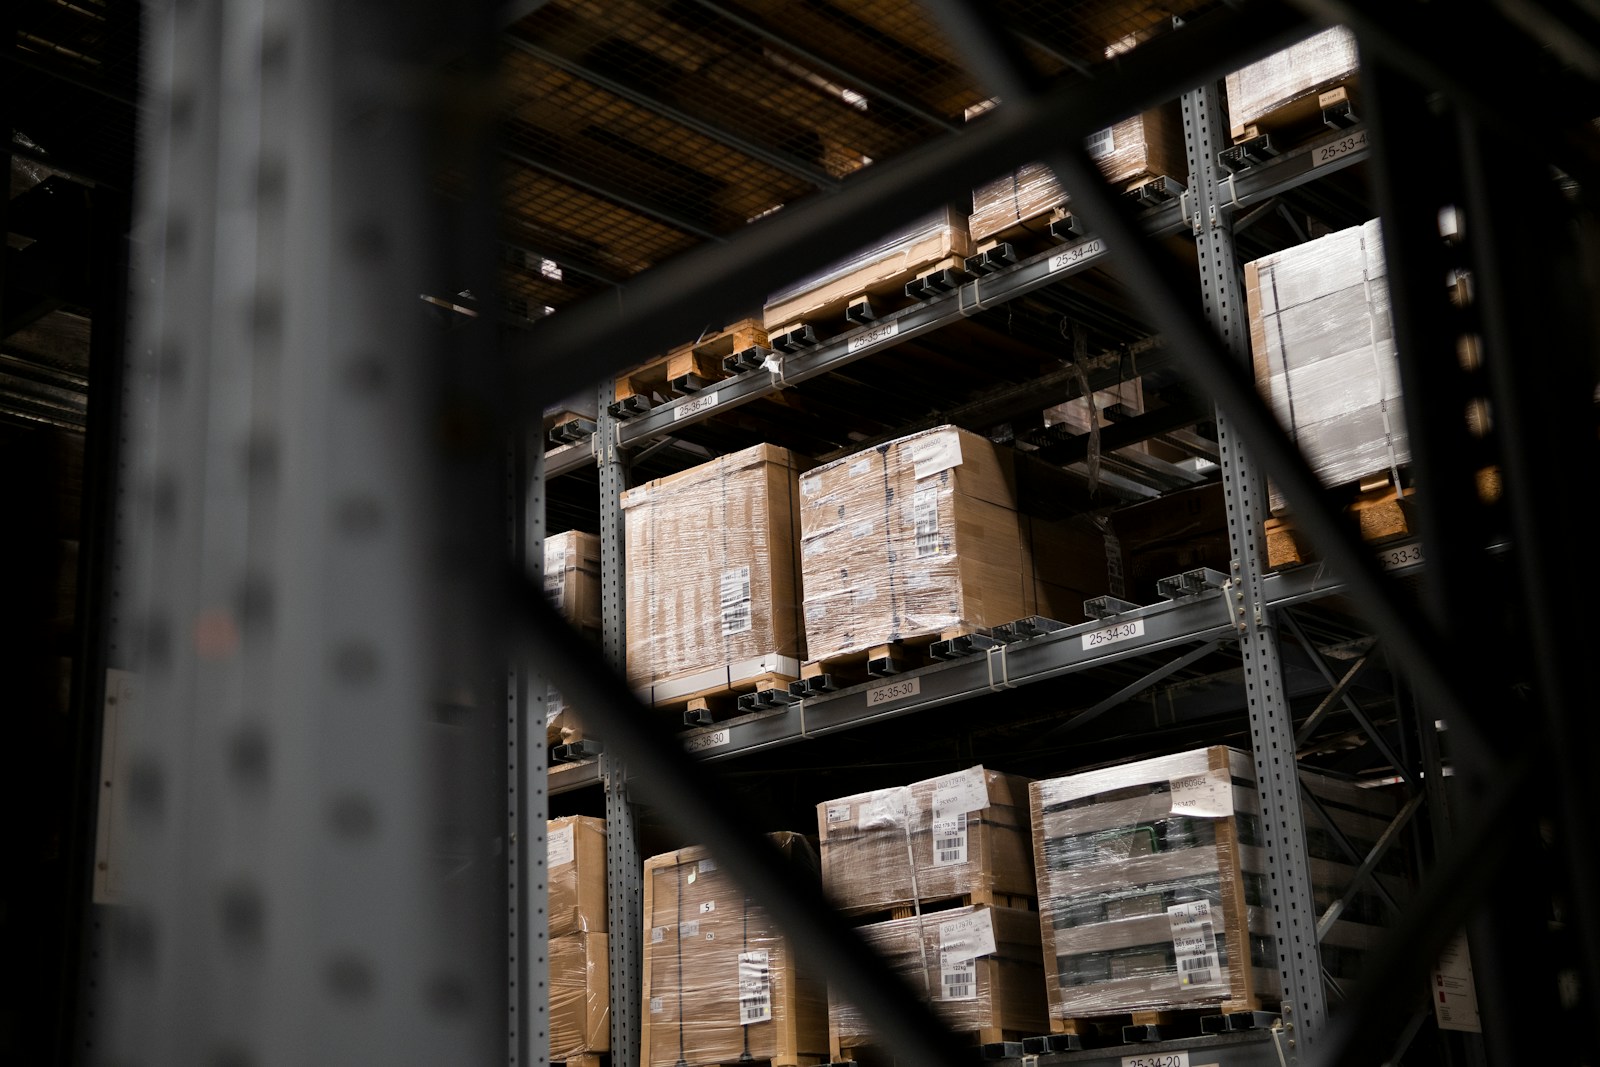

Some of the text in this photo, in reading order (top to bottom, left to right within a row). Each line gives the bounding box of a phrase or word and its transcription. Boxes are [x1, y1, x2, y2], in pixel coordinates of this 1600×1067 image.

[1321, 132, 1369, 161] 25-33-4
[1056, 241, 1100, 267] 25-34-40
[854, 324, 892, 348] 25-35-40
[679, 395, 713, 416] 25-36-40
[1089, 623, 1136, 646] 25-34-30
[873, 682, 913, 702] 25-35-30
[688, 732, 724, 751] 25-36-30
[1171, 777, 1207, 790] 30160964
[705, 903, 710, 912] 5
